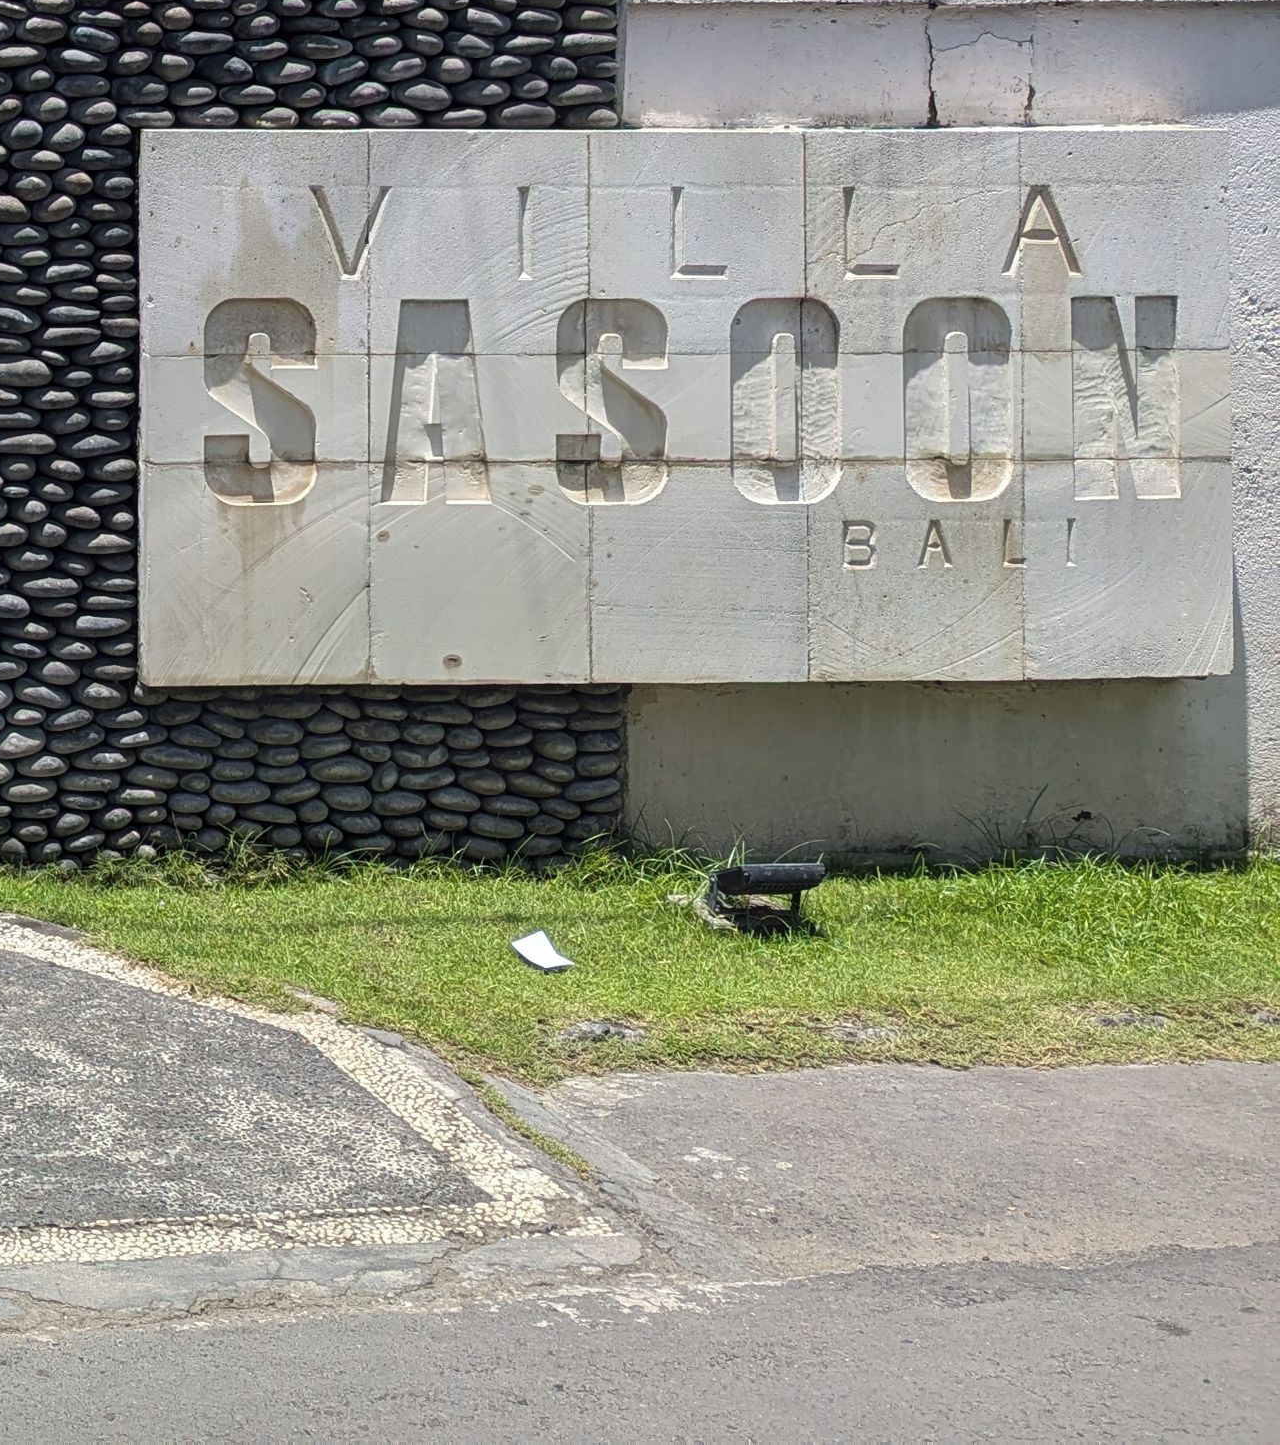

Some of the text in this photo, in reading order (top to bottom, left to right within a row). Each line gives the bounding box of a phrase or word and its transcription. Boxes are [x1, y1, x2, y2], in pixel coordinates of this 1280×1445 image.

[309, 185, 1083, 280] VILLA
[203, 296, 1180, 506] SASOON
[841, 518, 1077, 569] BALI
